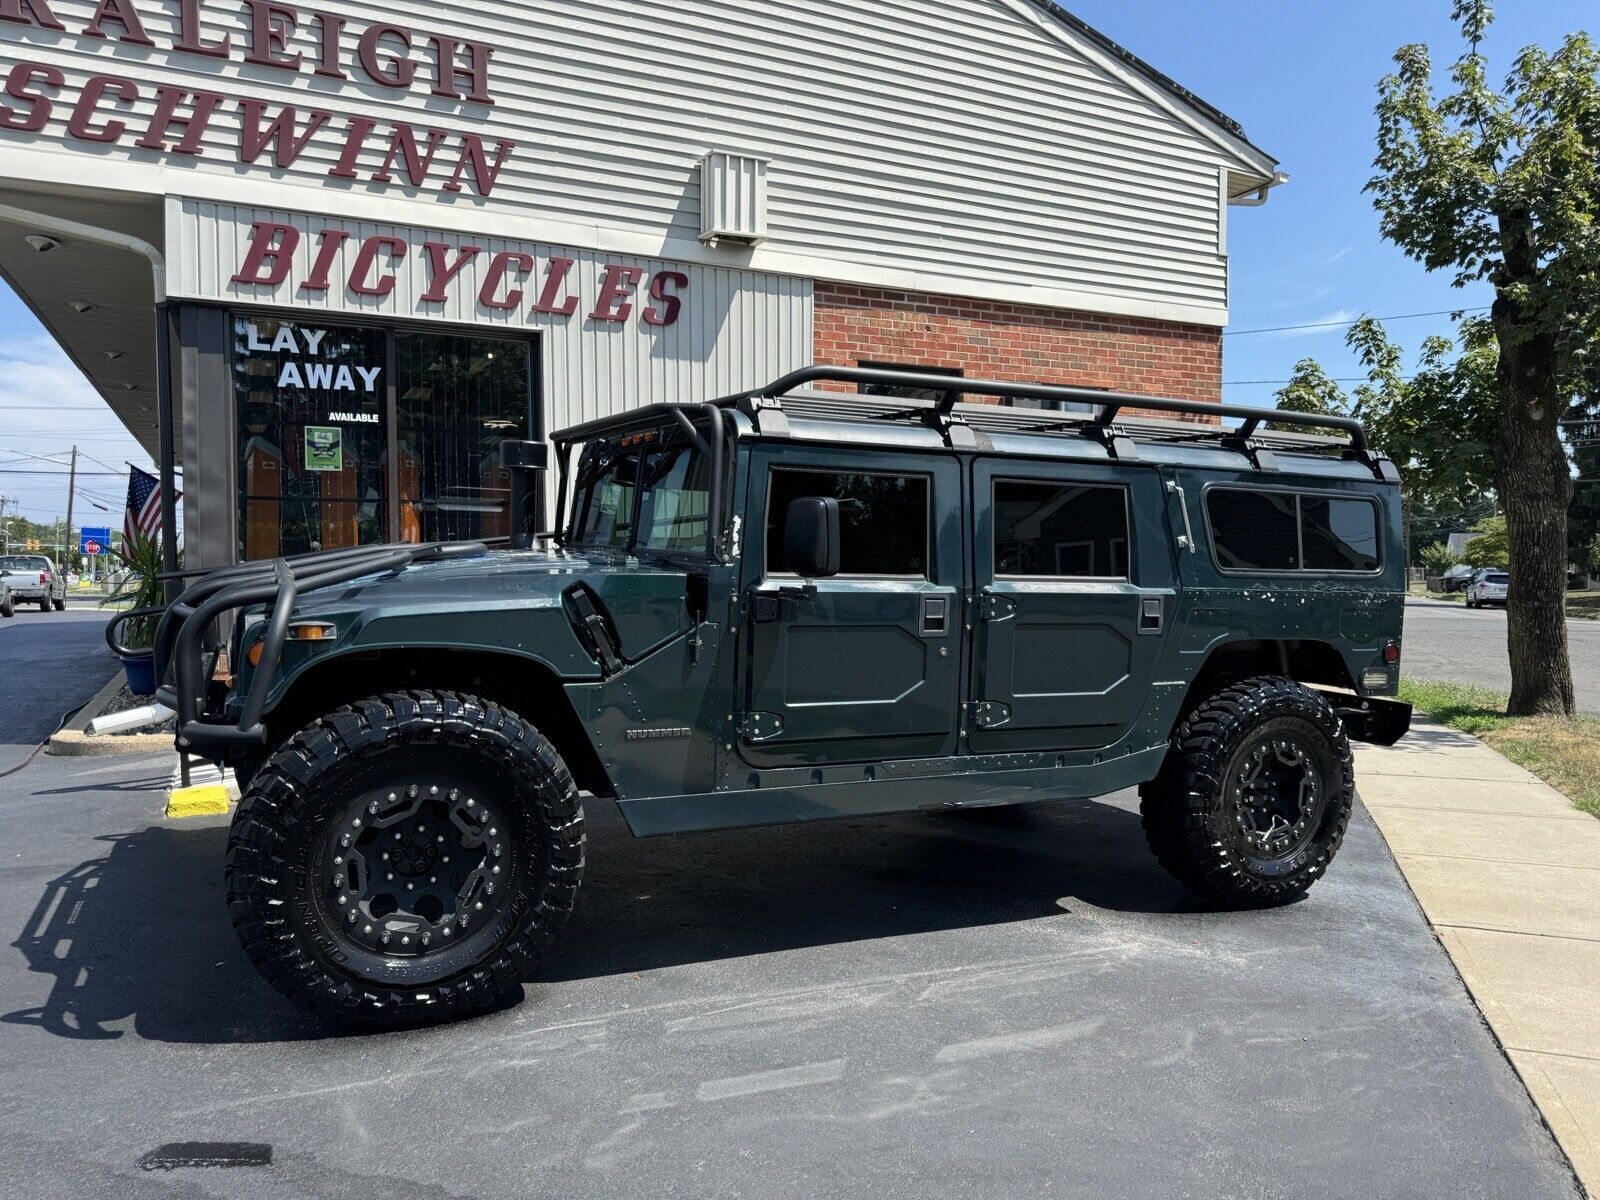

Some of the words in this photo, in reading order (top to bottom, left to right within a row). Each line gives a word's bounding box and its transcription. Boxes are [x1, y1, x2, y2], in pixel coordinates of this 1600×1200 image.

[0, 62, 515, 197] SCHWINN
[231, 221, 688, 326] BICYCLES
[247, 324, 326, 354] LAY
[277, 362, 382, 391] AWAY
[329, 412, 379, 422] AVAILABLE
